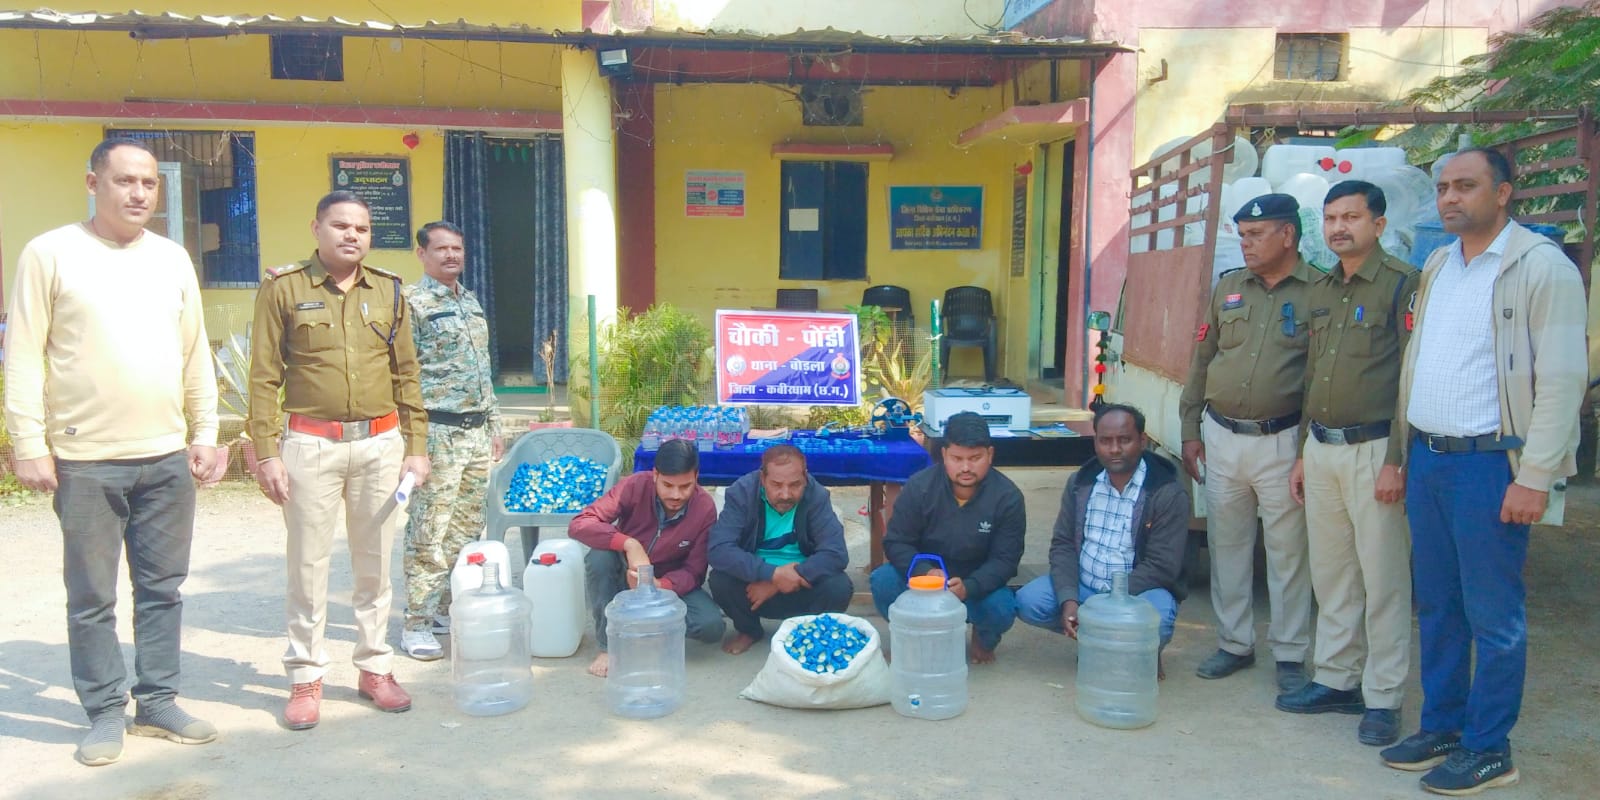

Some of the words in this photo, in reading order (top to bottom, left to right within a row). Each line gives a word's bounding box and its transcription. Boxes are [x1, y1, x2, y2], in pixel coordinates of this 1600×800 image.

[728, 322, 780, 347] चौकी
[751, 360, 778, 371] थाना
[728, 383, 756, 395] जिला
